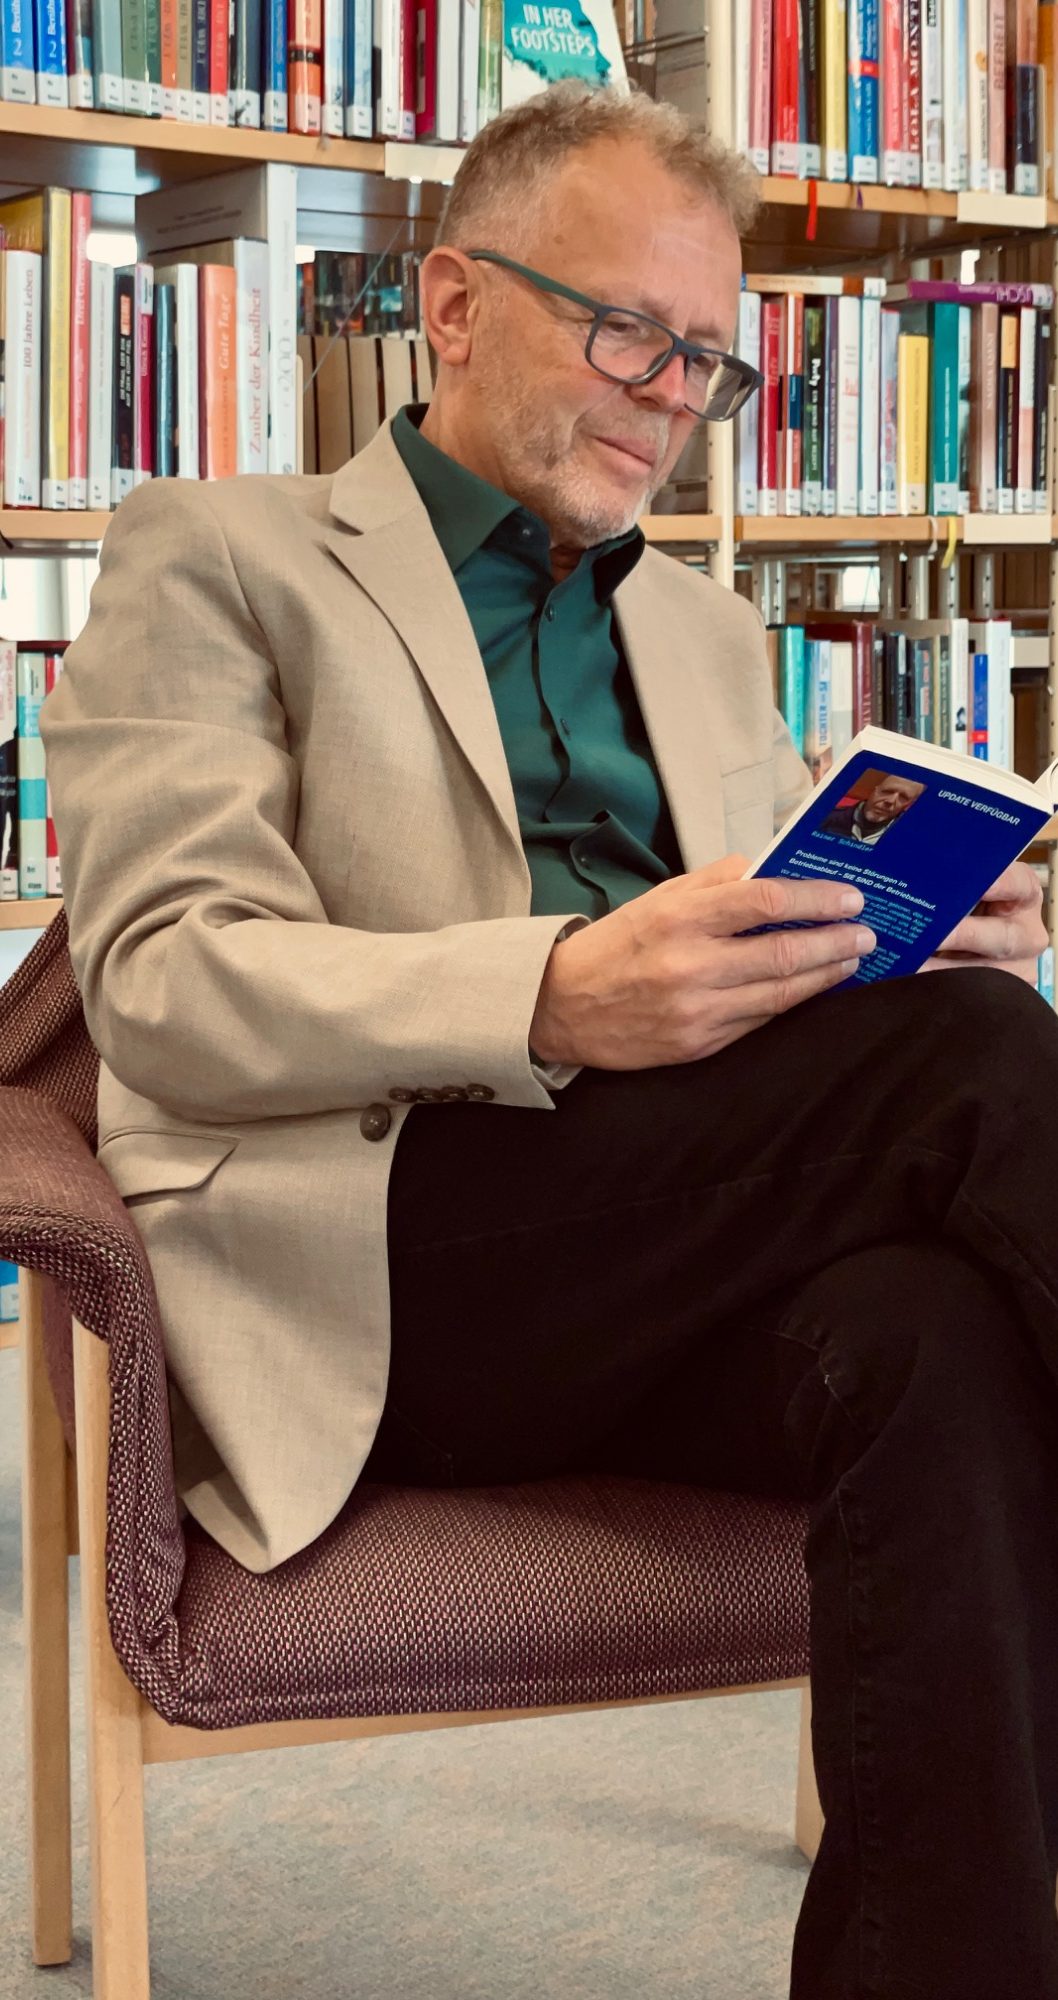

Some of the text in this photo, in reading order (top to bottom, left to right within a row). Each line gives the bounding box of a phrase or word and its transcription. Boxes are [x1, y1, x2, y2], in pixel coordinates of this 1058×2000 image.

[523, 4, 579, 34] IN HER
[13, 38, 22, 56] 2
[49, 40, 57, 58] 2
[511, 26, 596, 57] FOOTSTEPS
[23, 269, 33, 307] Leben
[23, 310, 33, 343] Jahre
[23, 346, 33, 368] 100
[219, 335, 230, 370] Gute
[248, 287, 261, 454] Zauber der Kindheit
[938, 790, 1021, 826] UPDATE VERFÜGBAR
[811, 830, 874, 852] Rainer Schindler
[789, 857, 838, 876] Betriebsablauf
[842, 870, 856, 881] SIE
[855, 876, 874, 886] SIND
[873, 881, 886, 890] der
[885, 886, 937, 911] Betriebsablauf.
[795, 849, 908, 888] Probleme sind keine Störungen im
